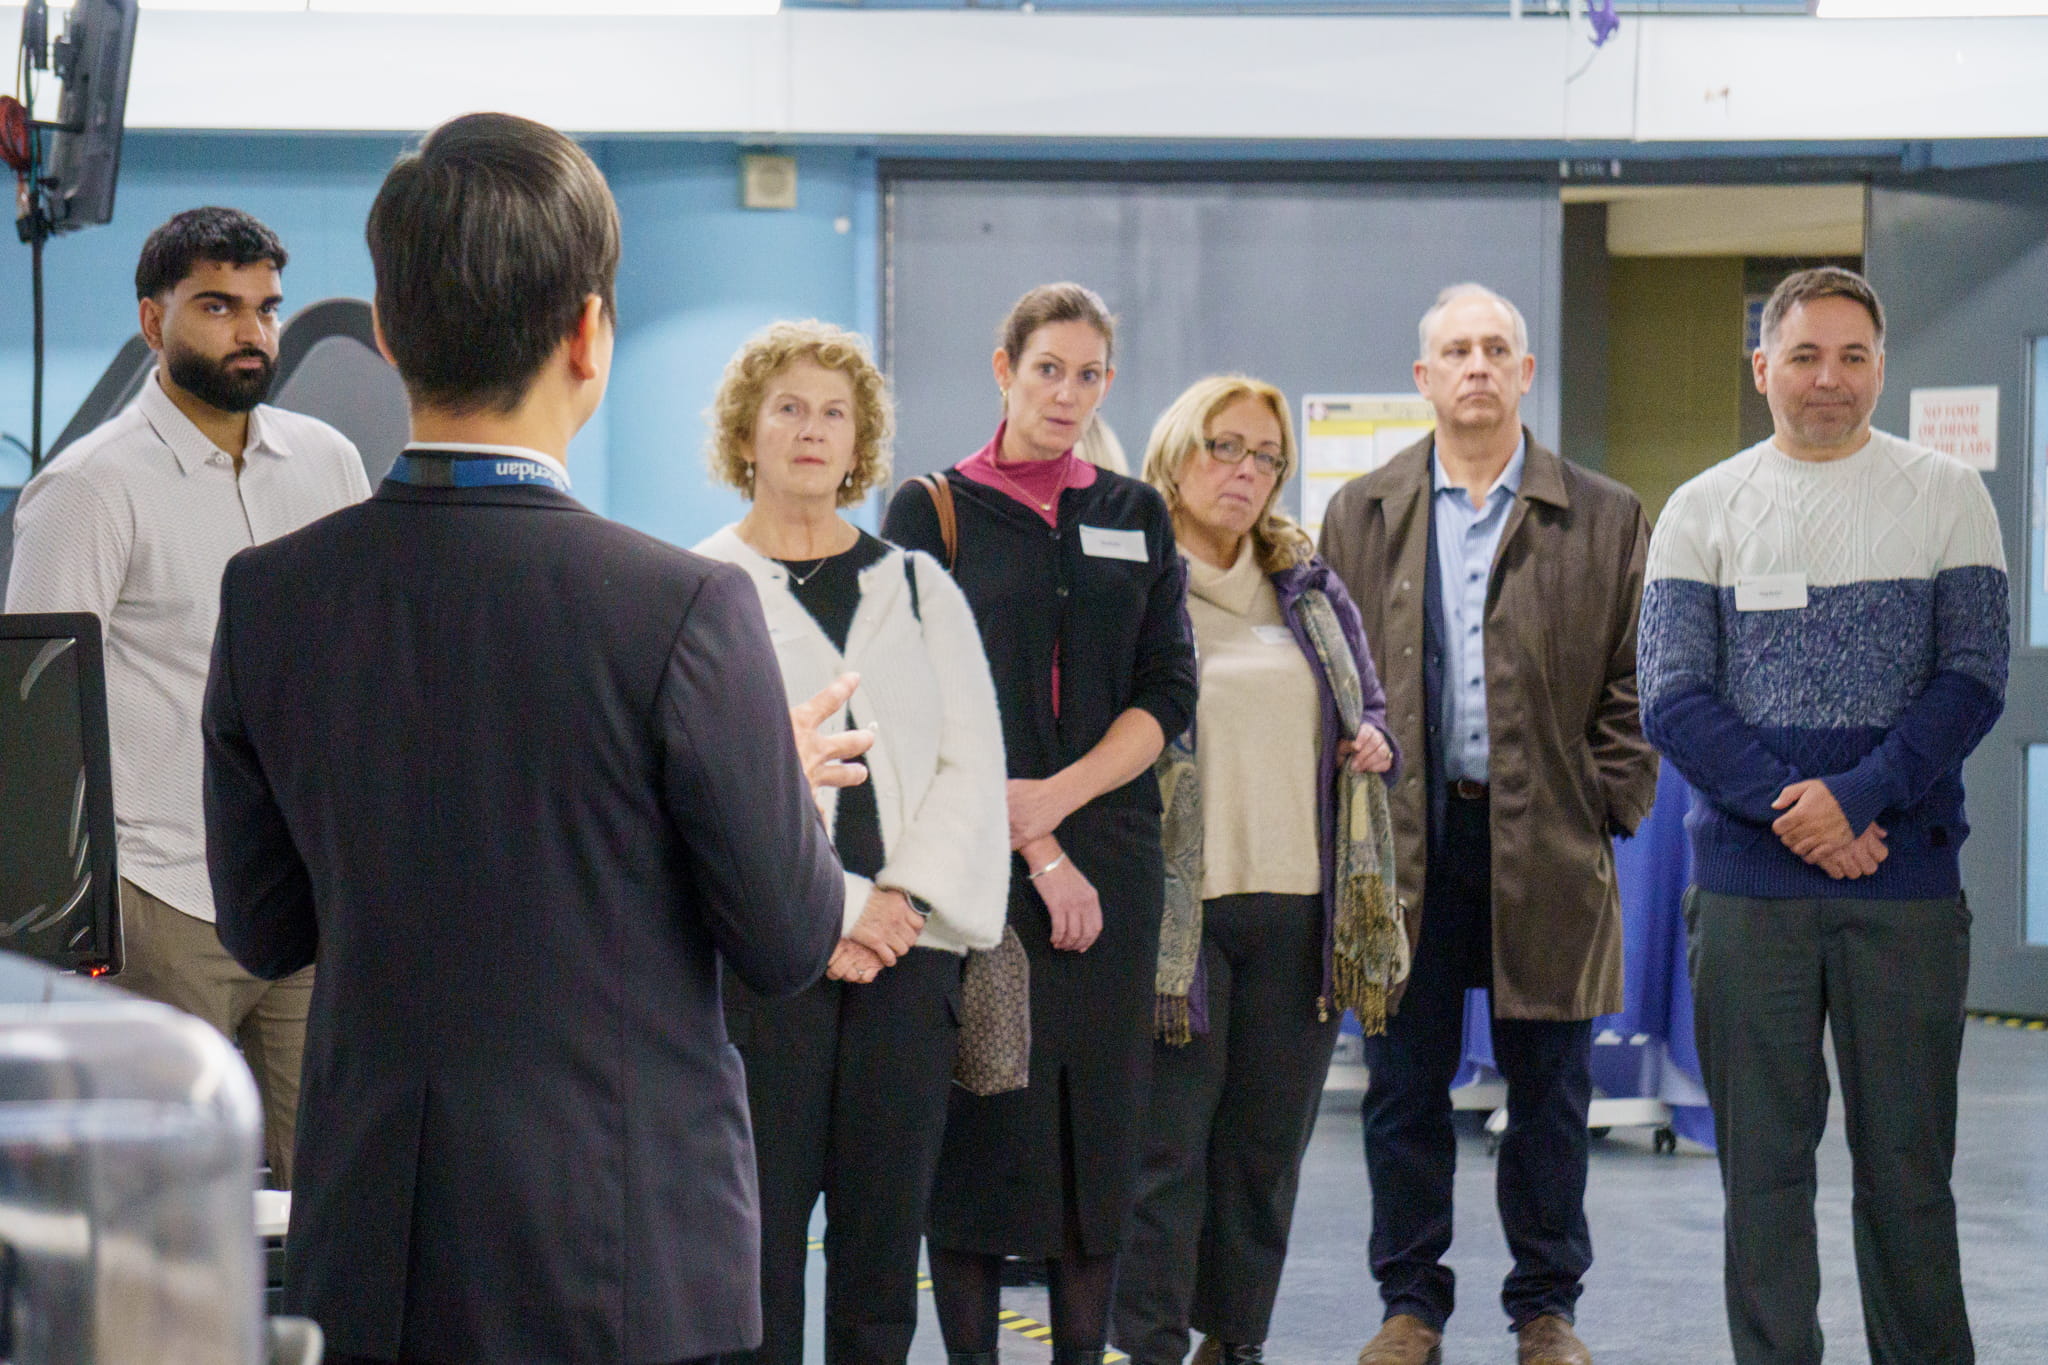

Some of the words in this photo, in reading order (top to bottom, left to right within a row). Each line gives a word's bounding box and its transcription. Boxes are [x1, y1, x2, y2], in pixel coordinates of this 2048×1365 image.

[1923, 405, 1942, 419] NO
[1944, 404, 1980, 418] FOOD
[1918, 422, 1935, 438] OR
[1939, 422, 1979, 437] DRINK
[1960, 439, 1991, 457] LABS
